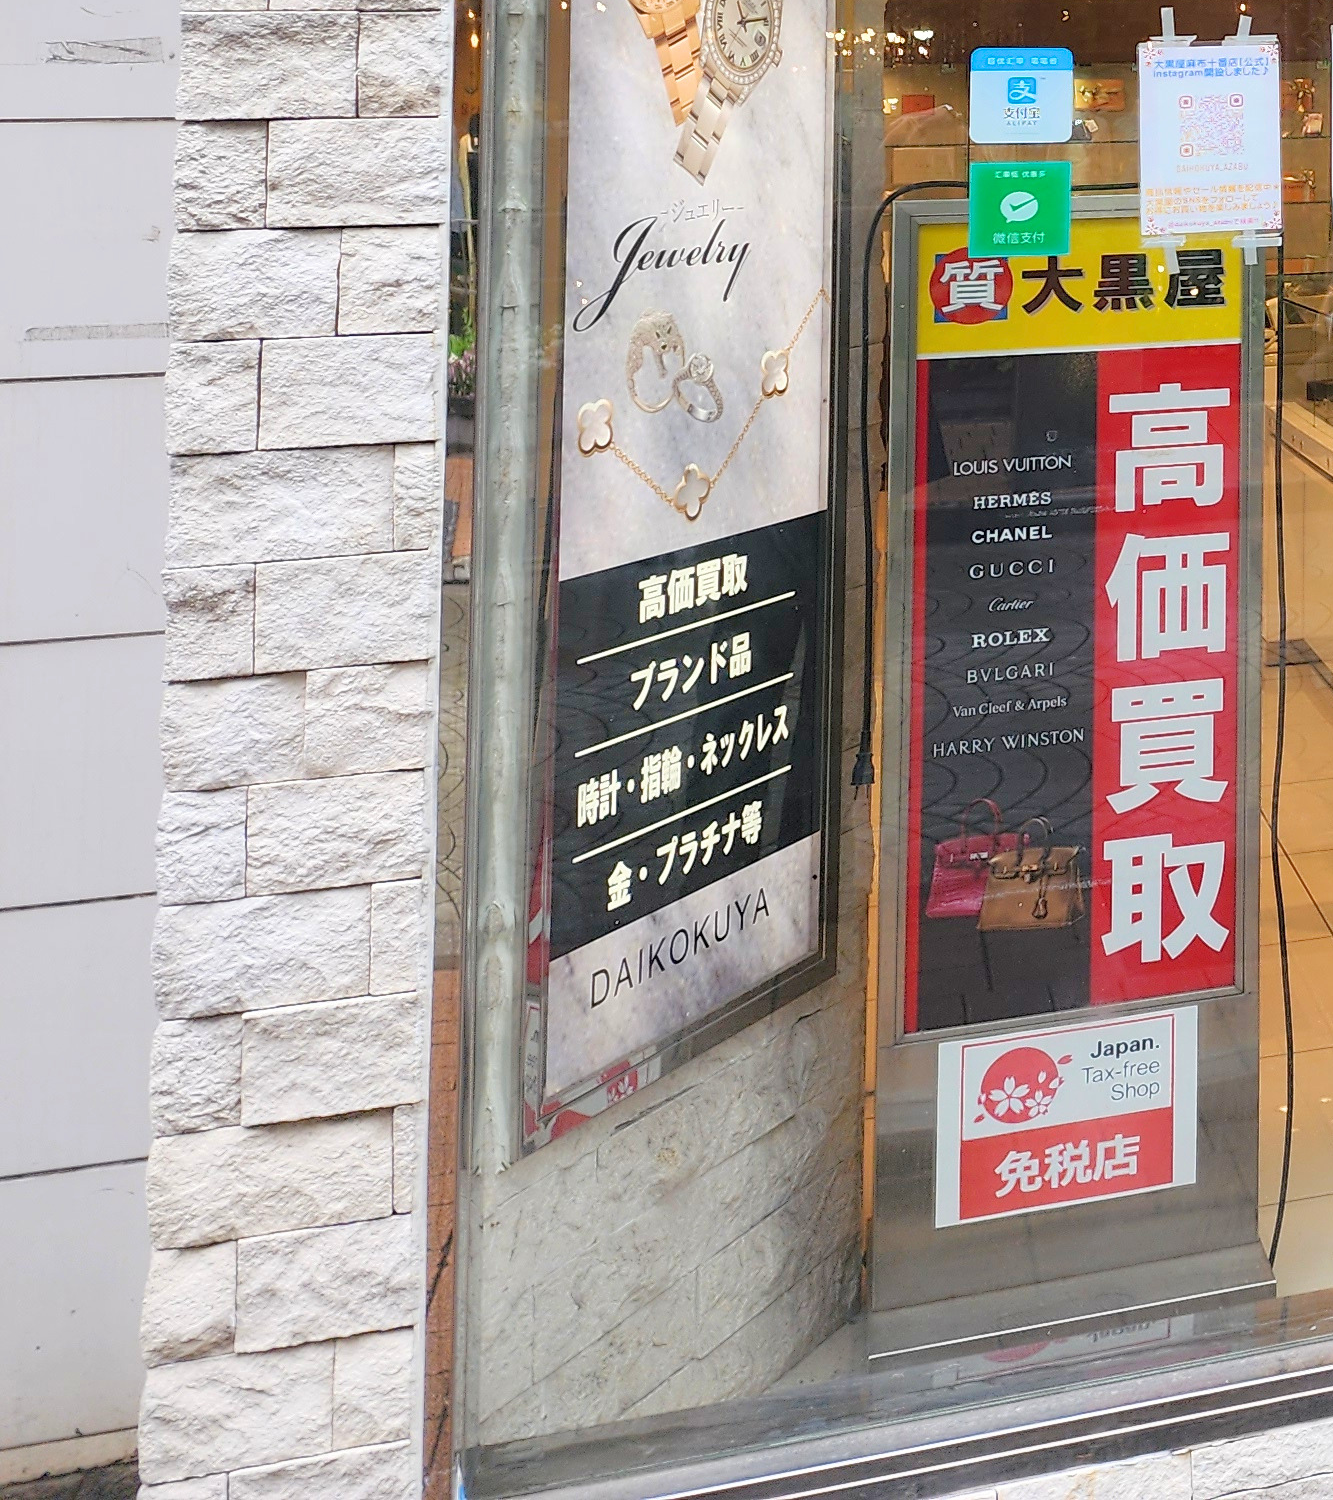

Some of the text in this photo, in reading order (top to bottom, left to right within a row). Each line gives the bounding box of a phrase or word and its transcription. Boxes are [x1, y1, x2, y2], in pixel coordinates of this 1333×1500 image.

[1003, 107, 1040, 119] 支付宝
[992, 231, 1046, 245] 微信支付
[573, 216, 750, 332] Jewelry
[939, 249, 1226, 315] 質 大黒屋
[953, 455, 1072, 476] LOUIS VUITTON
[972, 526, 1053, 543] CHANEL
[969, 559, 1054, 579] GUCCI
[638, 553, 747, 624] 高価買取
[988, 598, 1034, 612] Cartier
[972, 627, 1050, 648] ROLEX
[631, 632, 753, 712] ブランド品
[967, 662, 1054, 683] BVLGARI
[1101, 383, 1231, 963] 高価買取
[953, 696, 1067, 717] Van Cleef & Arpels
[933, 728, 1085, 758] HARRY WINSTON
[577, 705, 790, 829] 時計・指輪・ネックレス
[607, 801, 762, 912] 金・プラチナ等
[590, 887, 770, 1010] DAIKOKUYA
[1090, 1035, 1160, 1059] Japan.
[1081, 1058, 1161, 1084] Tax-free
[1110, 1079, 1160, 1102] Shop
[994, 1133, 1140, 1198] 免税店
